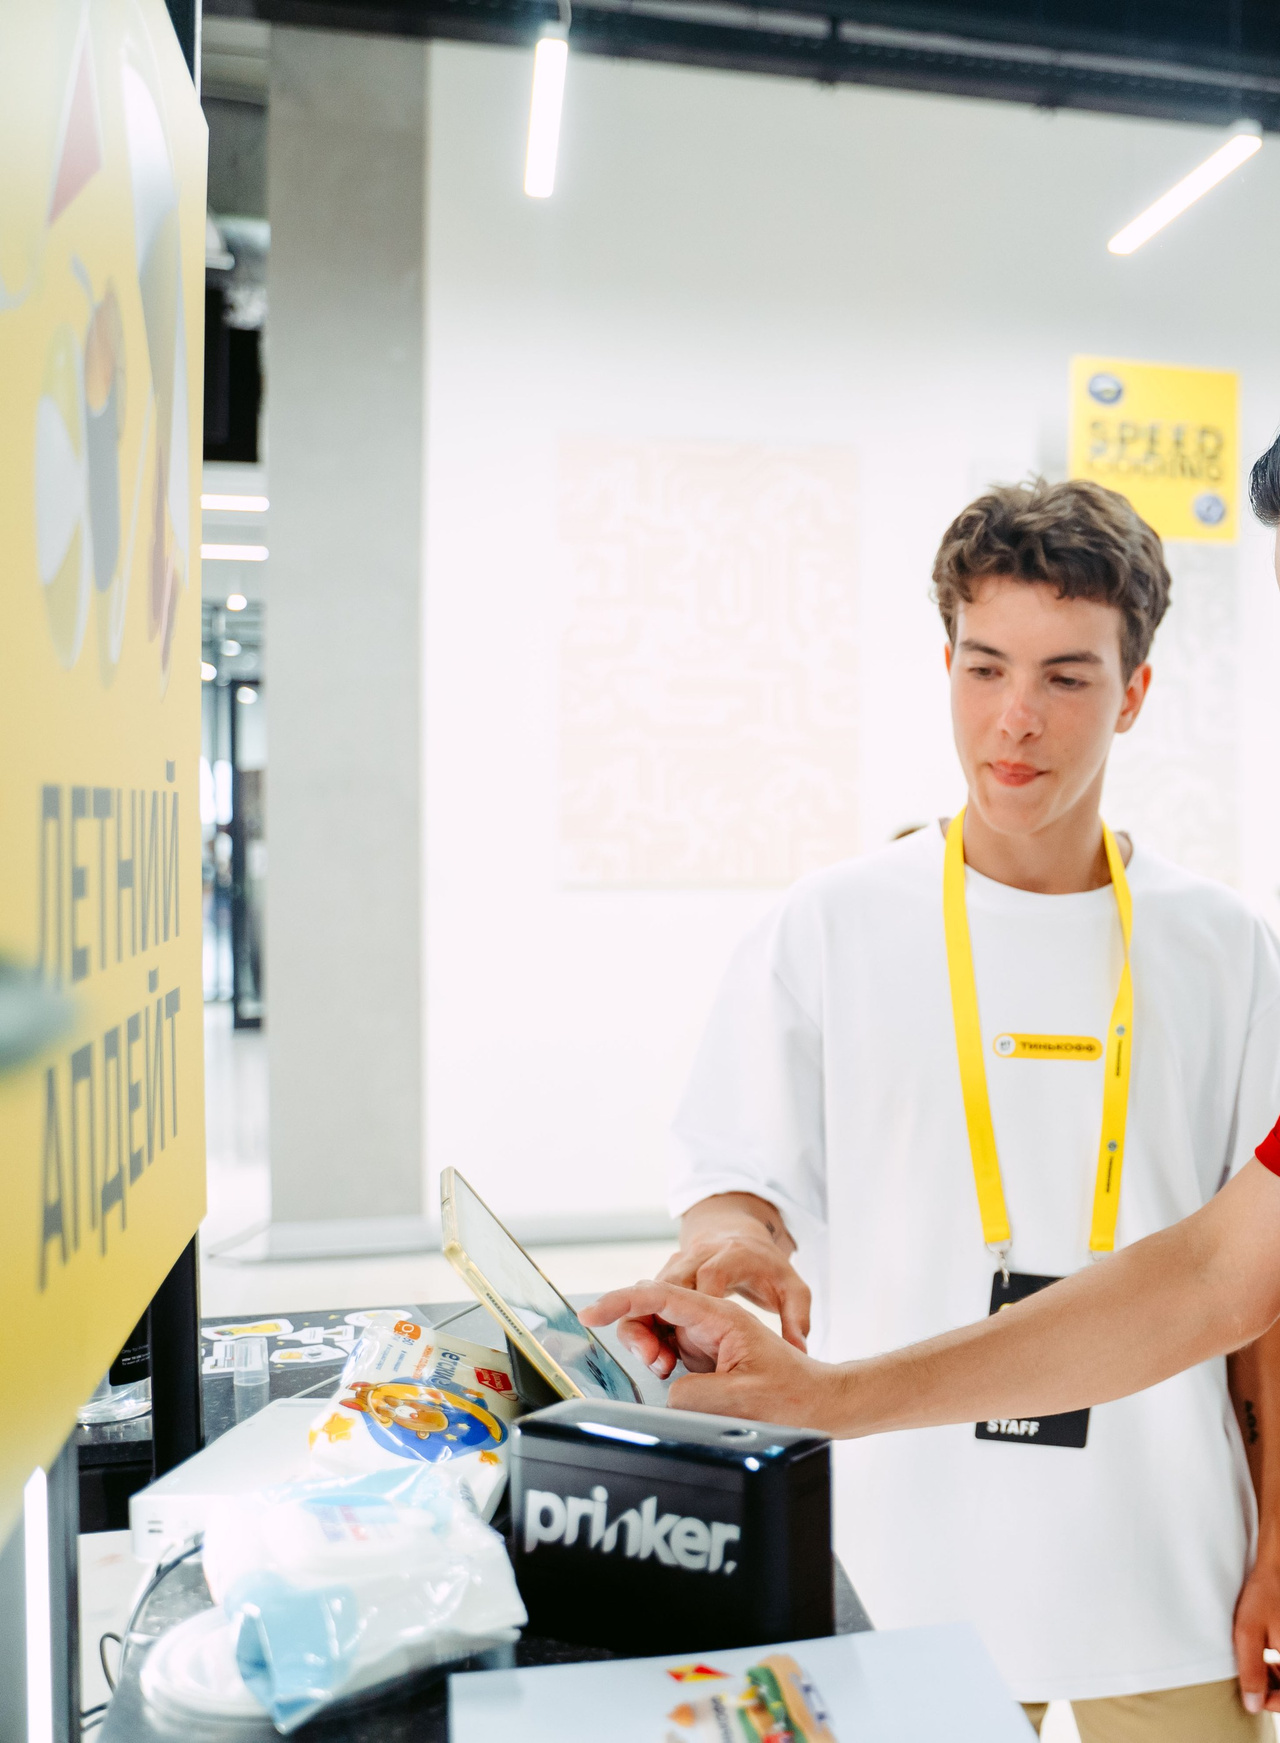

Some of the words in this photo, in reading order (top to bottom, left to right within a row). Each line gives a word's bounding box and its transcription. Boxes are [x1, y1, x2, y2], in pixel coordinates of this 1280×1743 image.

[37, 760, 180, 993] ЛЕТНИЙ
[1021, 1041, 1095, 1053] ТИНЬКОФФ
[38, 967, 181, 1293] АПДЕЙТ
[986, 1419, 1040, 1436] STAFF
